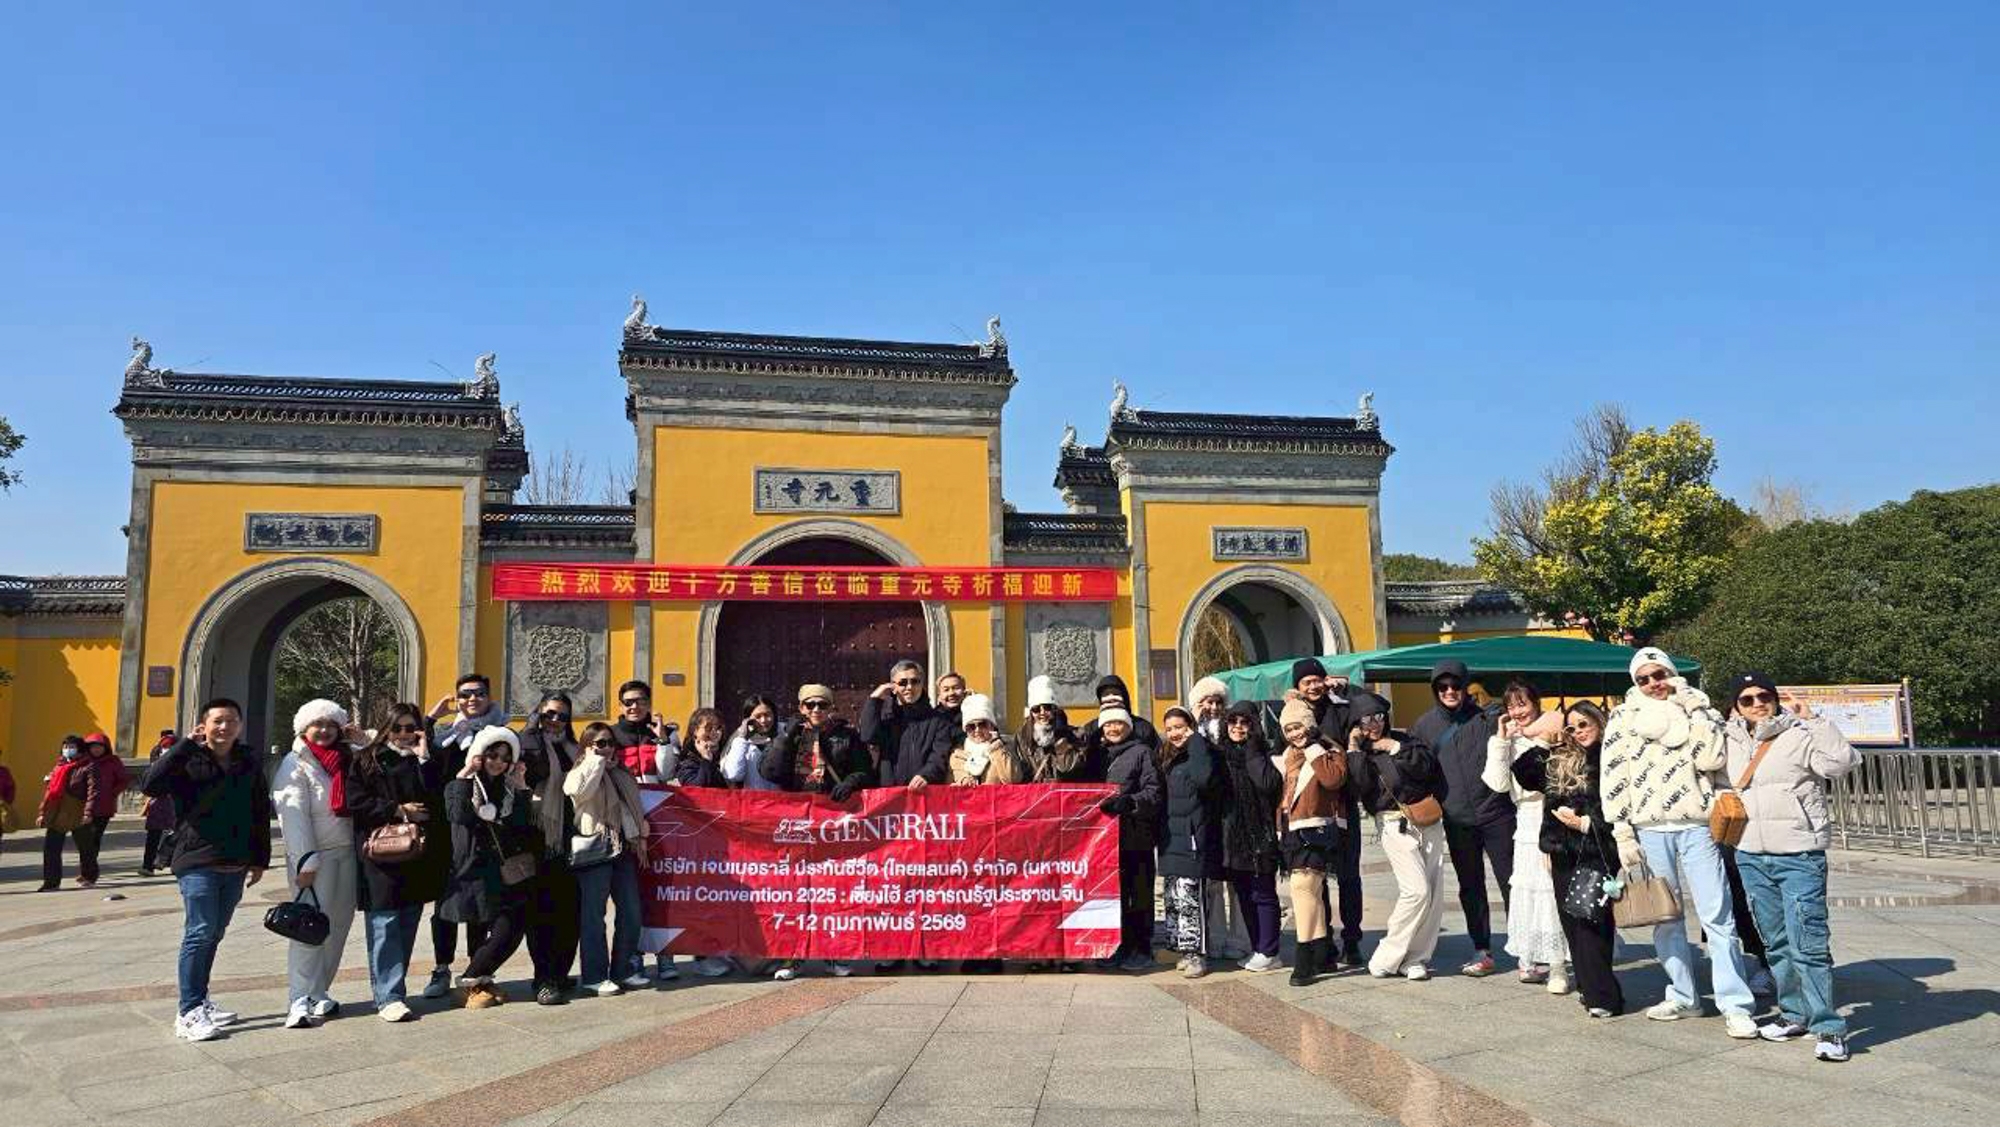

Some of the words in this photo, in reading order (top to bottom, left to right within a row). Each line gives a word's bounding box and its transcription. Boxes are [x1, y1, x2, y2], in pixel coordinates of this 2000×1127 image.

[819, 813, 967, 843] GENERALI
[653, 857, 696, 874] บริษัท
[702, 854, 790, 875] เจนเนอราลี่
[795, 858, 879, 876] ประกันชีวิต
[974, 858, 1018, 875] จำกัด
[1023, 857, 1088, 878] (มหาชน)
[656, 886, 690, 902] Mini
[695, 886, 792, 903] Convention
[797, 887, 836, 903] 2025
[904, 884, 1083, 907] สาธารณรัฐประชาชนจีน
[823, 911, 915, 938] กุมภาพันธ์
[921, 914, 966, 931] 2569
